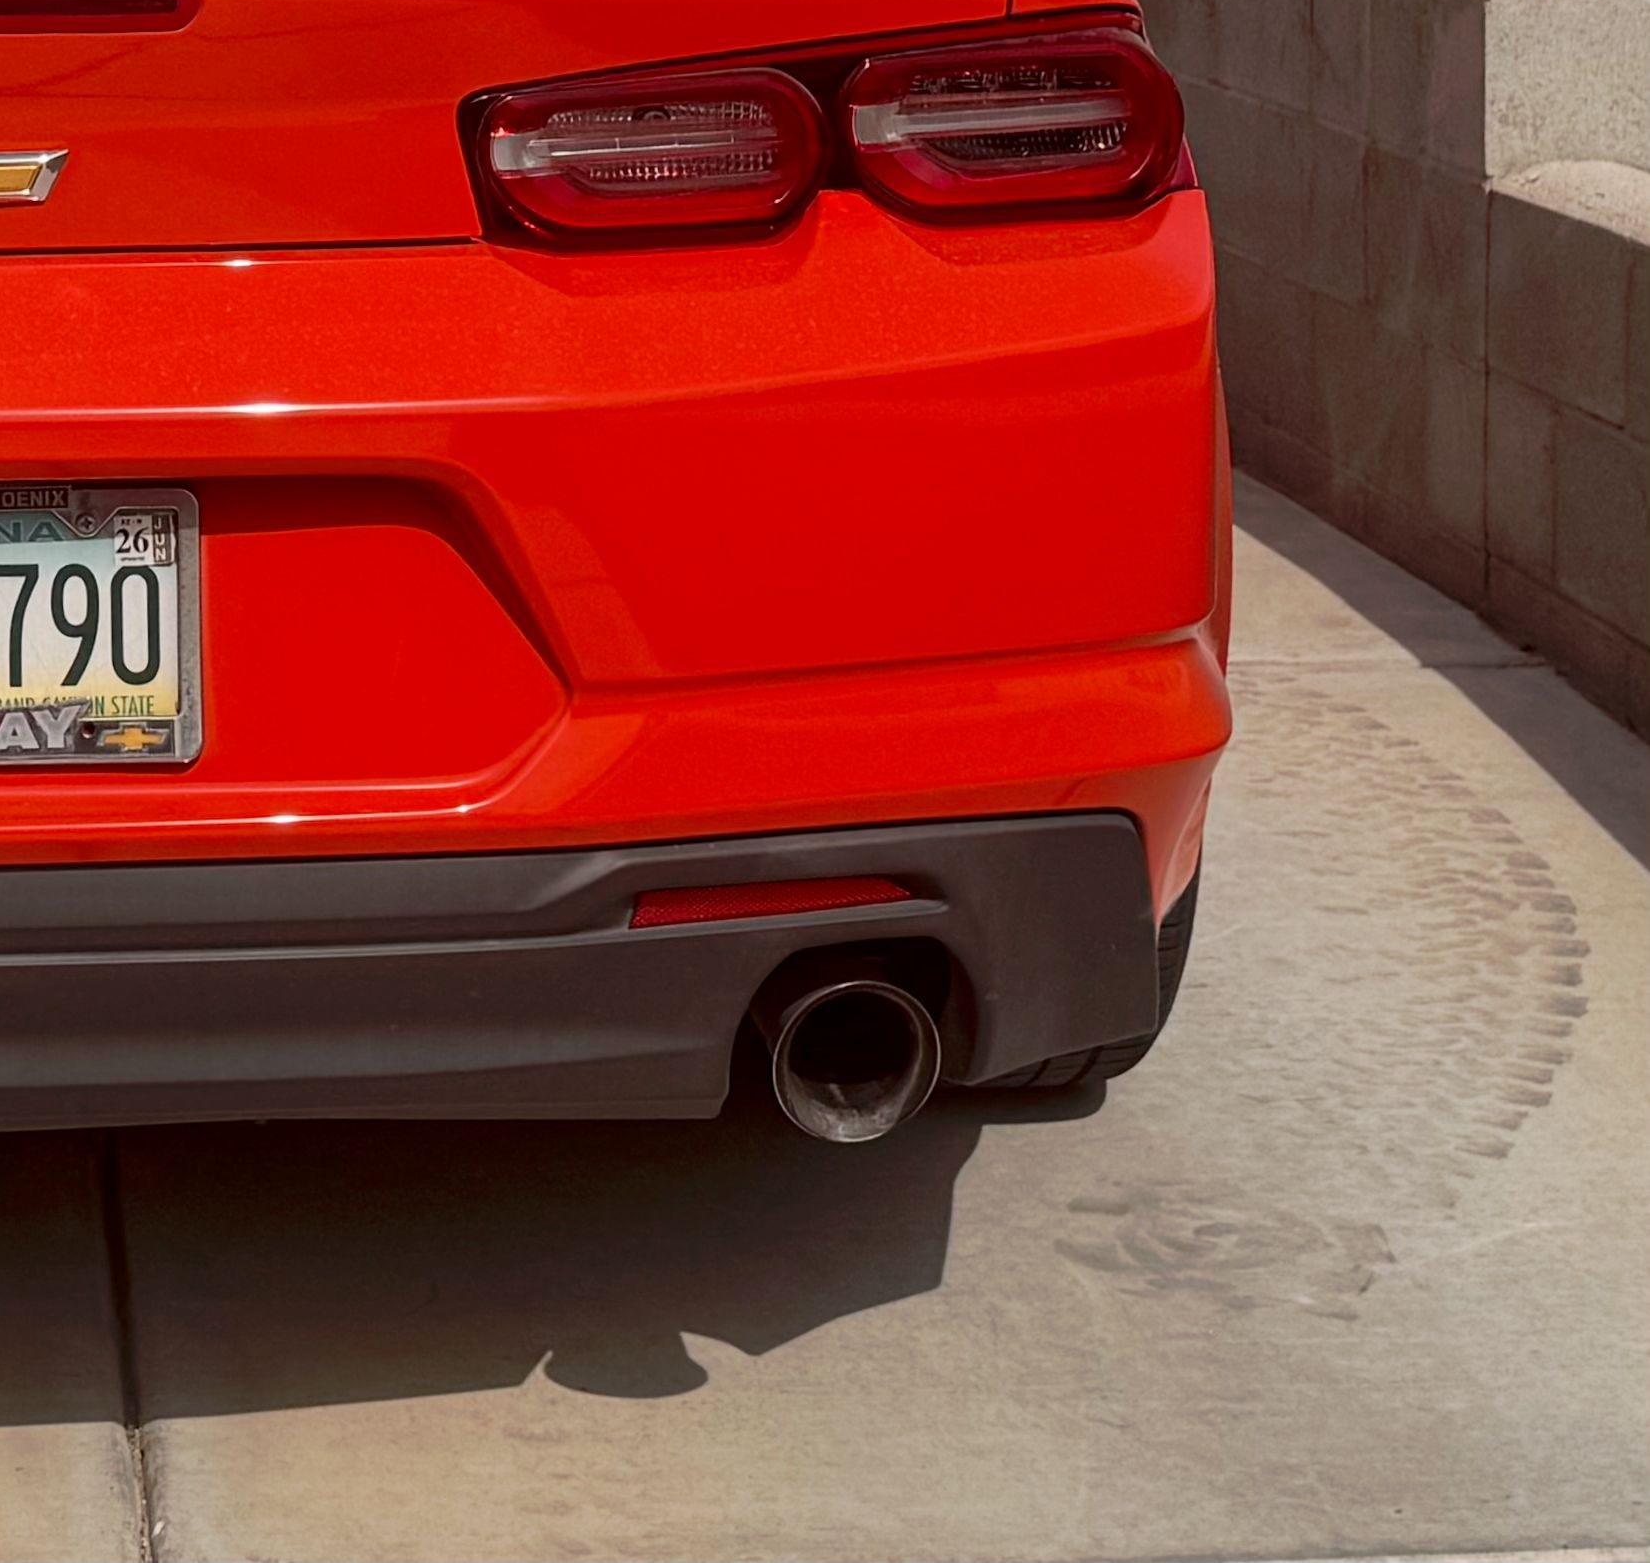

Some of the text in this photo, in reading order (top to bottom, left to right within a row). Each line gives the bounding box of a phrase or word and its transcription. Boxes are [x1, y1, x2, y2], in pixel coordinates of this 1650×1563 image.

[116, 527, 149, 554] 26
[154, 517, 166, 561] JUN
[114, 695, 155, 715] STATE
